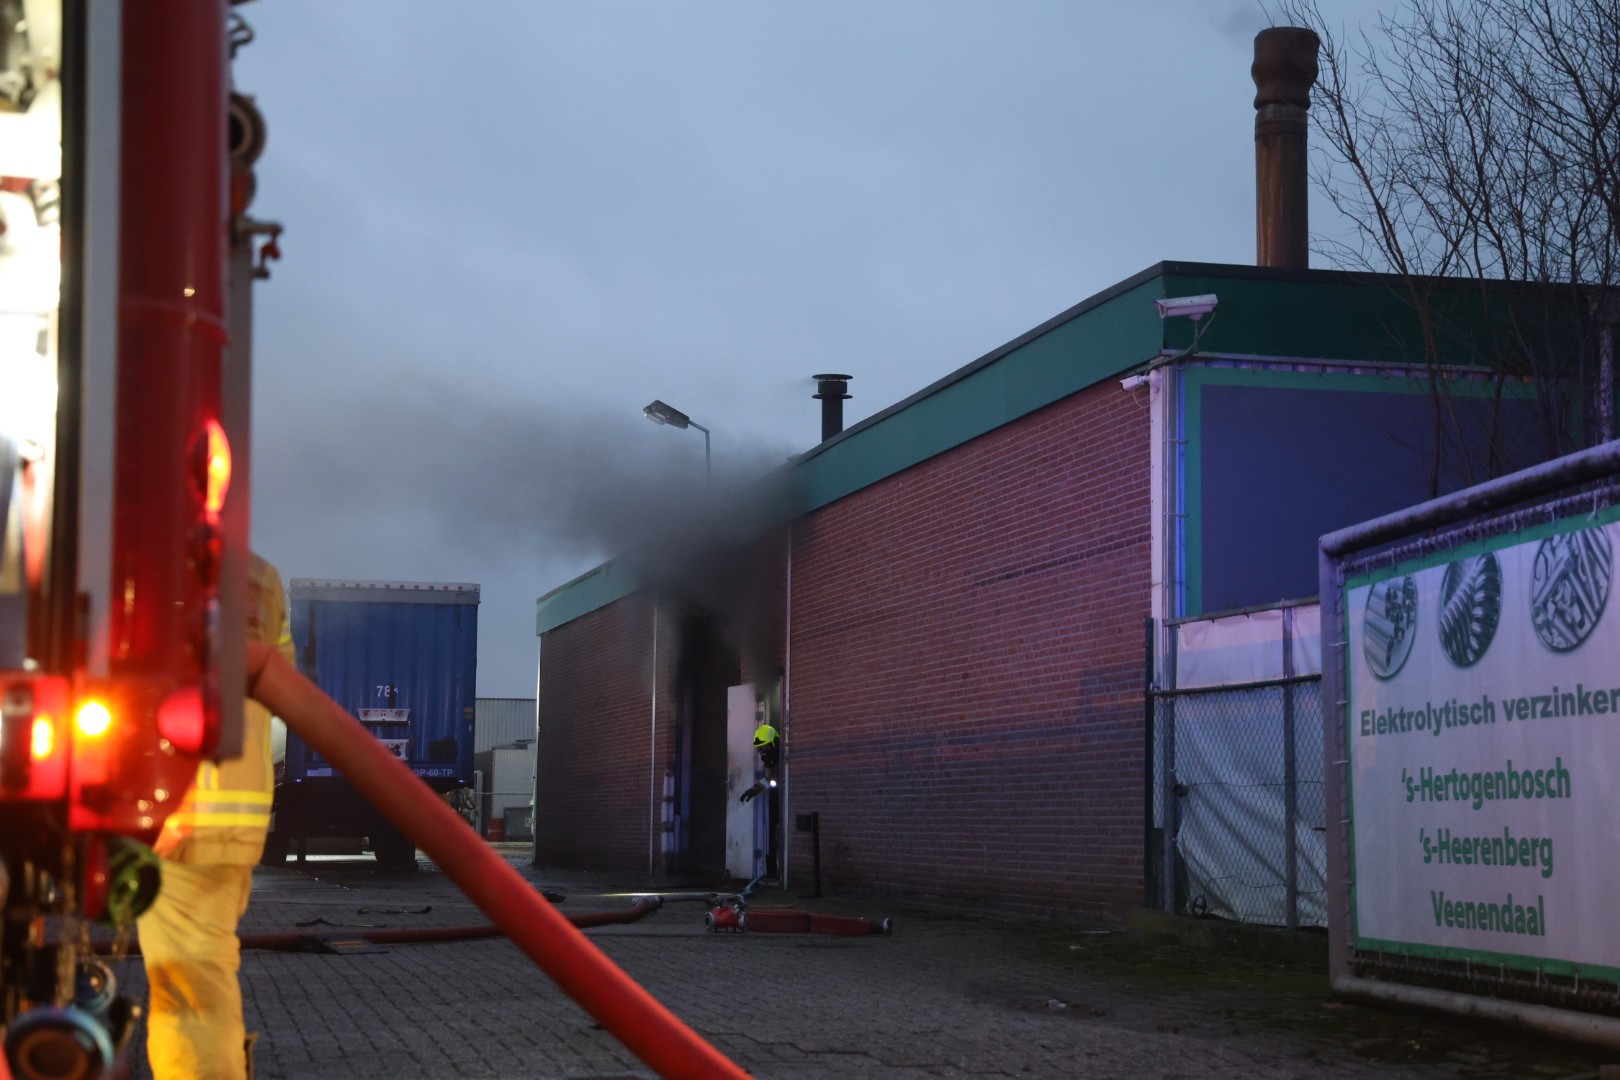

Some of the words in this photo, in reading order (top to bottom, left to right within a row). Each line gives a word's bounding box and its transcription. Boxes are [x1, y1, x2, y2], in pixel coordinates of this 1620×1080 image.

[1361, 695, 1496, 736] Elektrolytisch
[1402, 757, 1571, 809] 's-Hertogenbosch
[1420, 827, 1553, 878] 's-Heerenberg
[1431, 891, 1545, 936] Veenendaal
